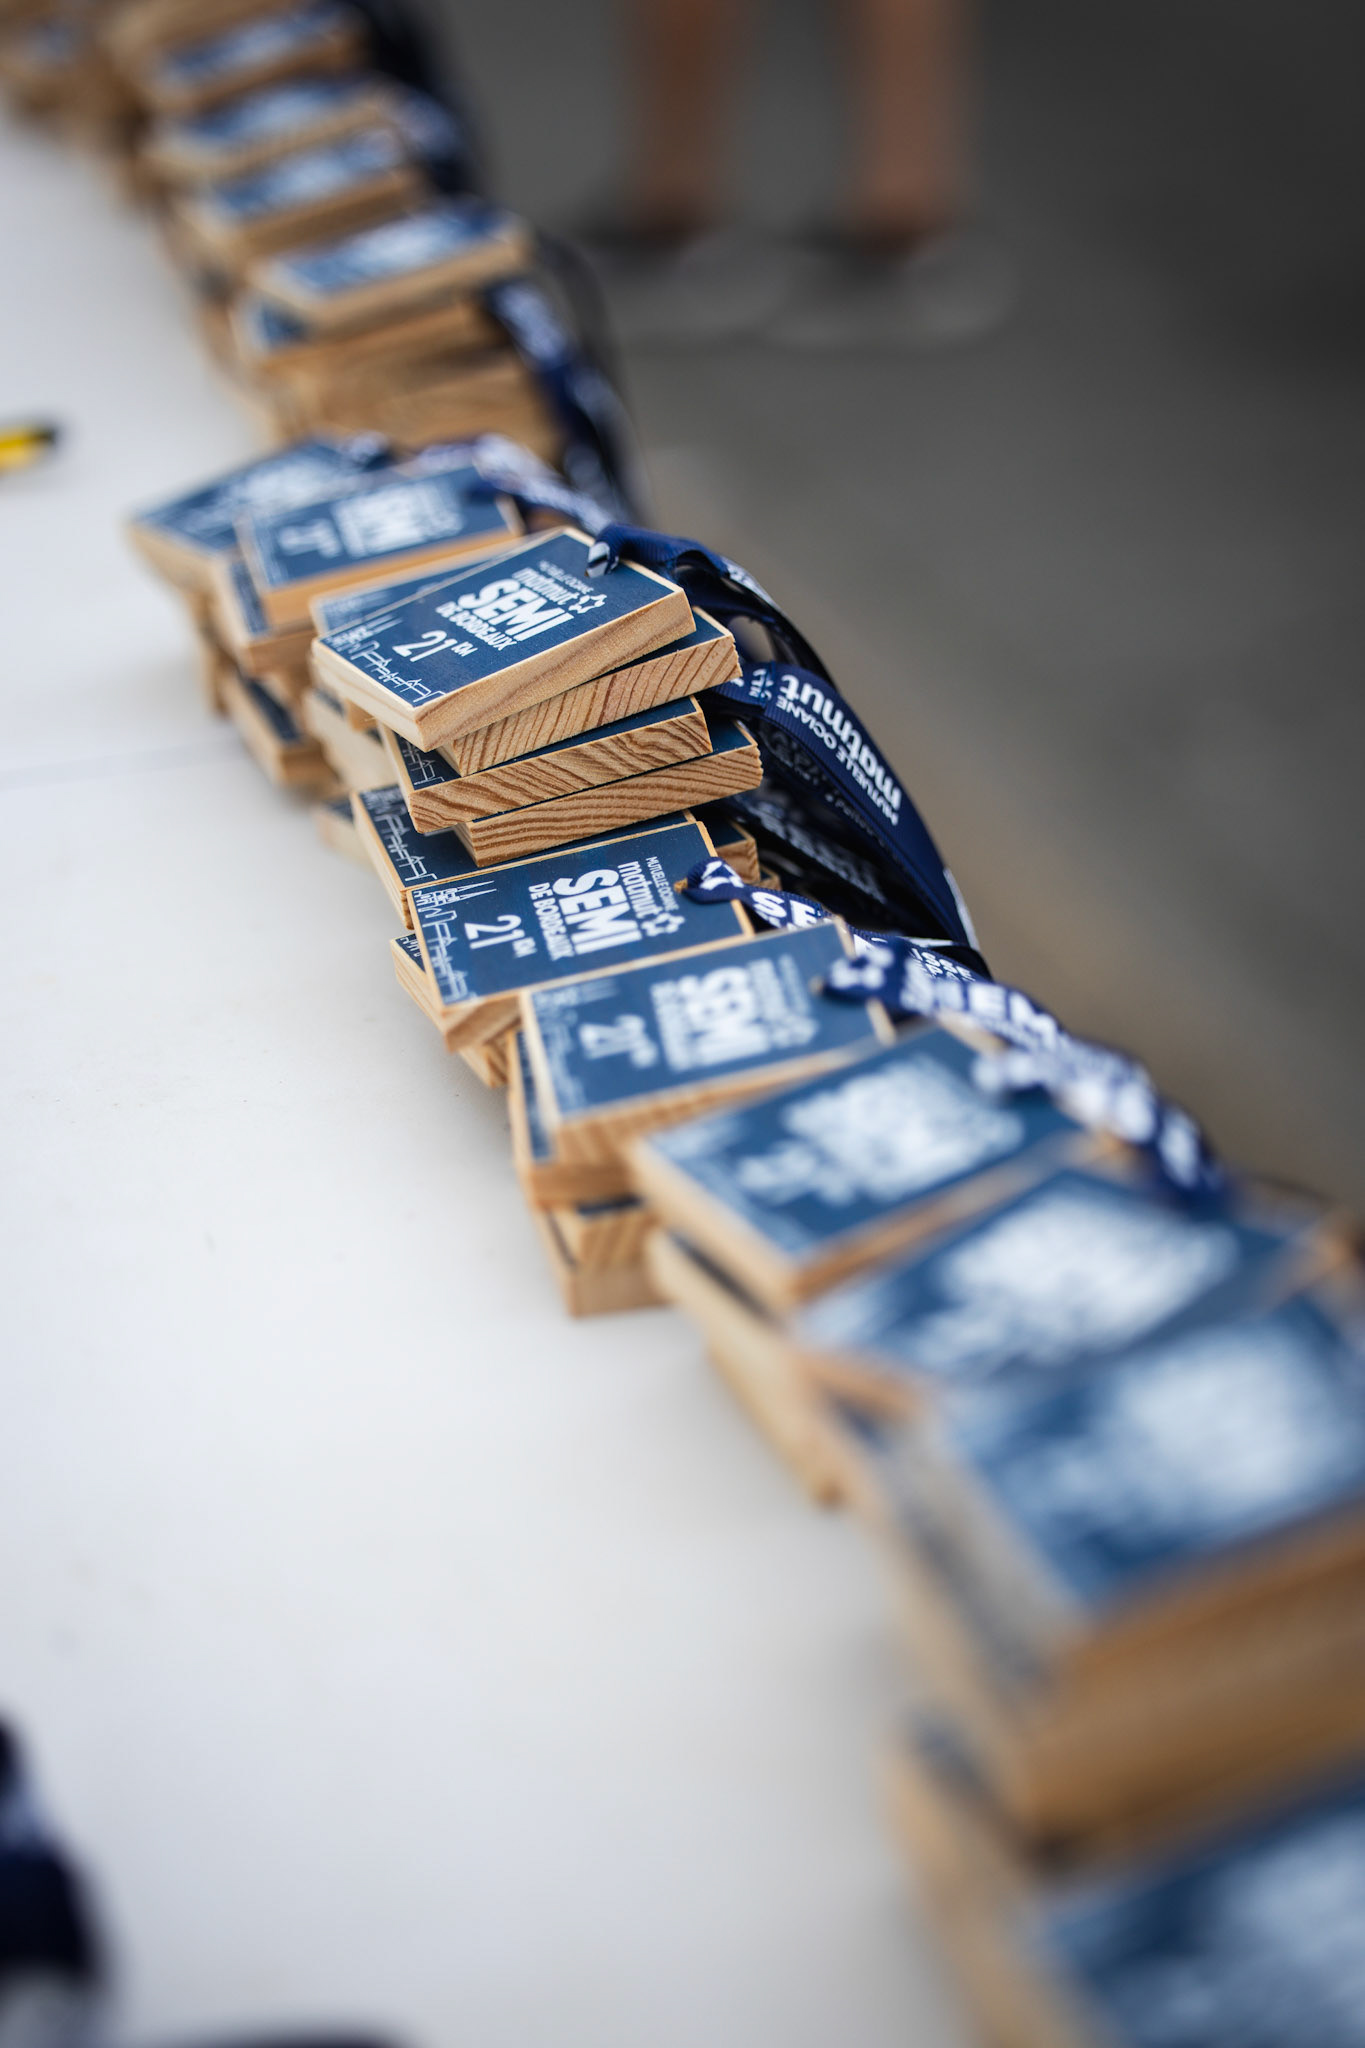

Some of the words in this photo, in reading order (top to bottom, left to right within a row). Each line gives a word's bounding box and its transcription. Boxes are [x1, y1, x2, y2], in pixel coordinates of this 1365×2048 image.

[435, 601, 460, 620] DE
[450, 611, 517, 651] BORDEAUX
[458, 578, 574, 642] SEMI
[392, 630, 457, 662] 21
[776, 696, 837, 749] OCIANE
[779, 674, 901, 810] matmut
[836, 748, 899, 826] MUTUELLE
[528, 882, 551, 900] DE
[617, 861, 664, 919] matmut
[646, 856, 668, 892] MUTUELLE
[464, 914, 525, 950] 21
[533, 897, 577, 961] BORDEAUX
[552, 869, 643, 955] SEMI
